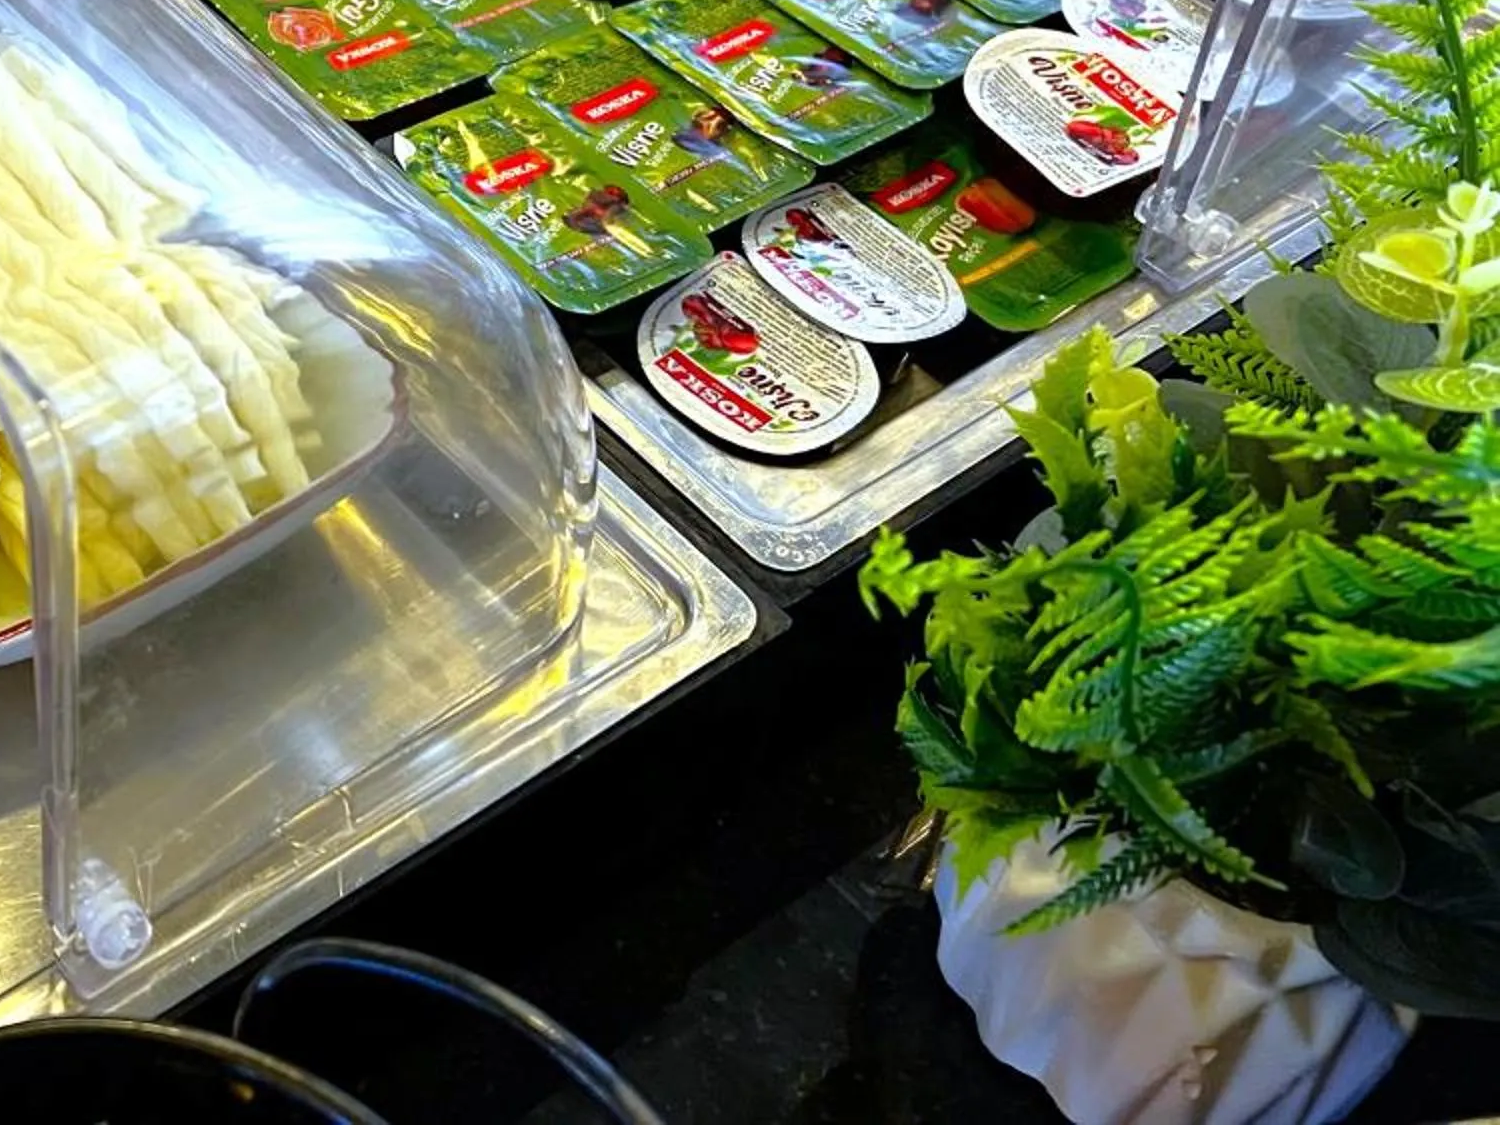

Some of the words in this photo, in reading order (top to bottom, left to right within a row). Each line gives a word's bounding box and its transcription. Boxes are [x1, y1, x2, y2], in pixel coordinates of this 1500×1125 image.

[1027, 55, 1094, 111] Vişne
[1084, 52, 1175, 128] KOSKA
[608, 121, 665, 168] Vişne
[887, 173, 946, 208] KOSKA
[662, 358, 765, 432] KOSKA
[735, 364, 821, 423] Vişne
